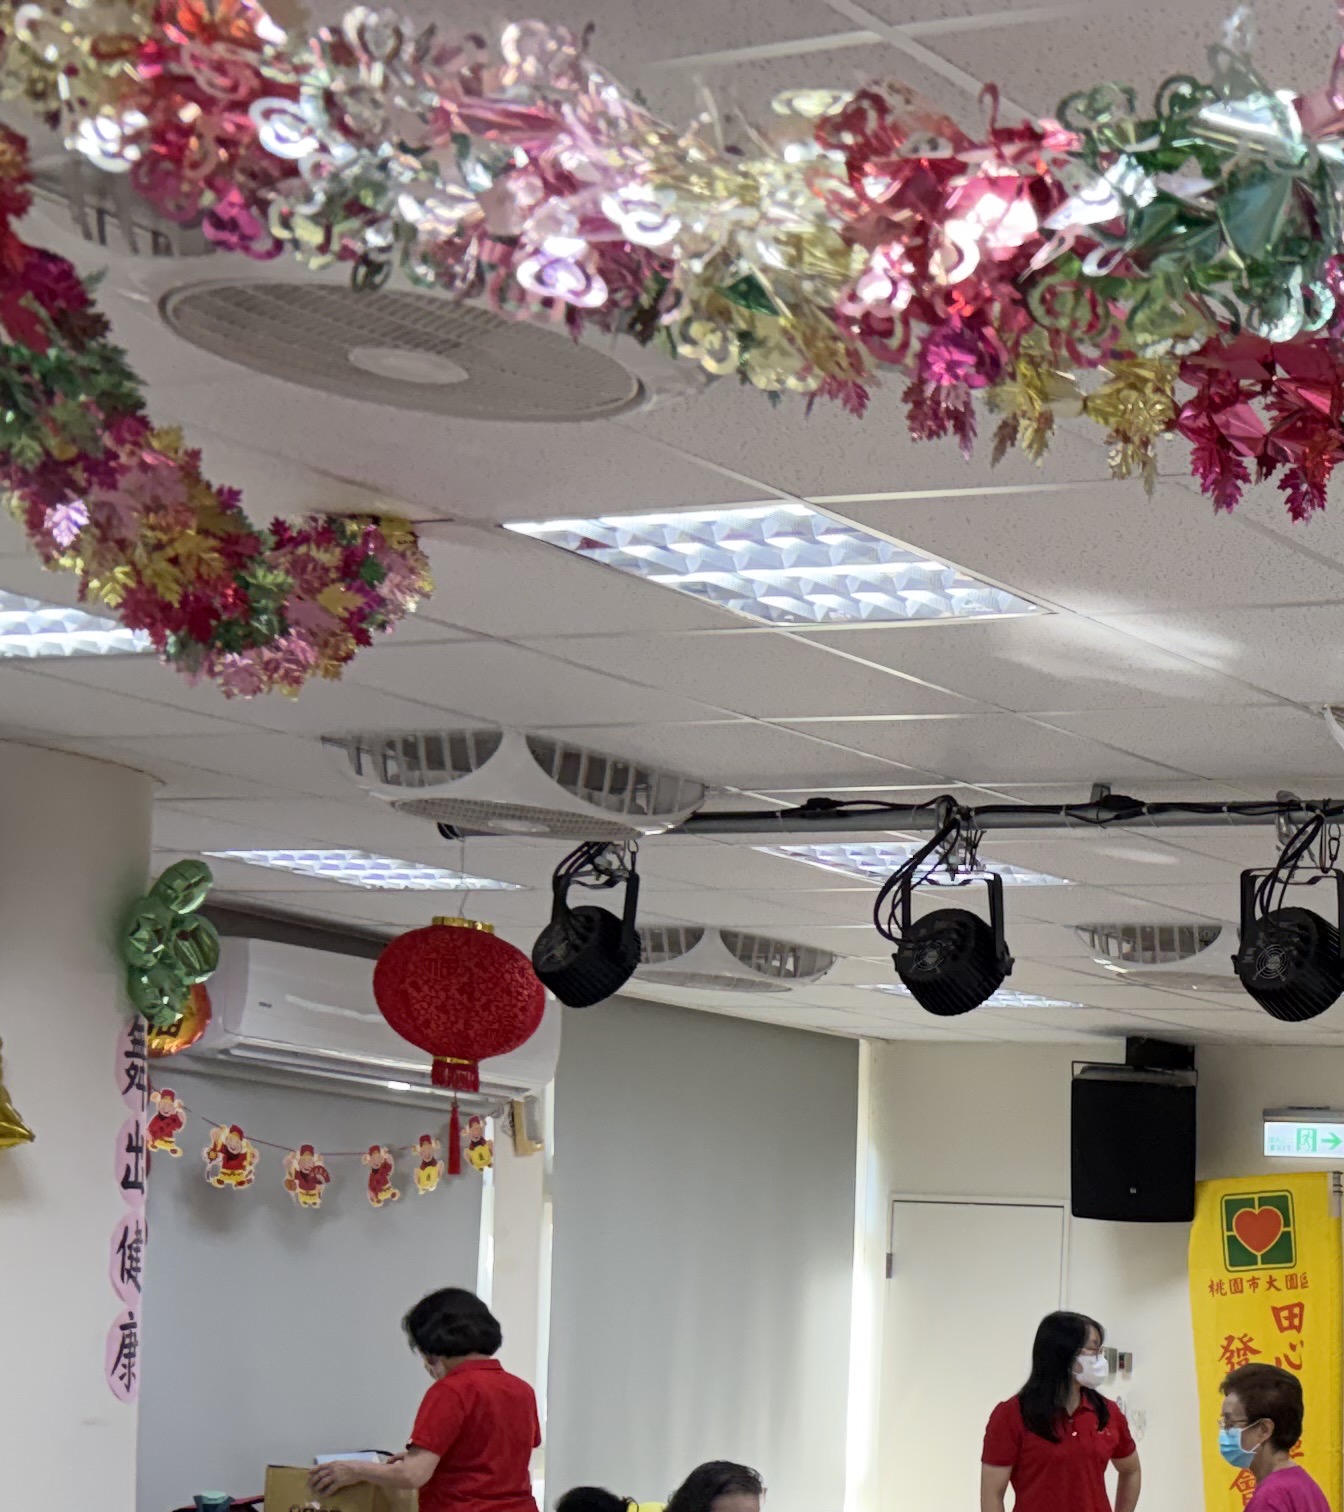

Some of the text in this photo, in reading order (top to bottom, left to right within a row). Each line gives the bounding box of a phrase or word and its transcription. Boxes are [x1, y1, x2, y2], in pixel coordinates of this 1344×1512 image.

[1208, 1272, 1310, 1297] 桃園市大園區
